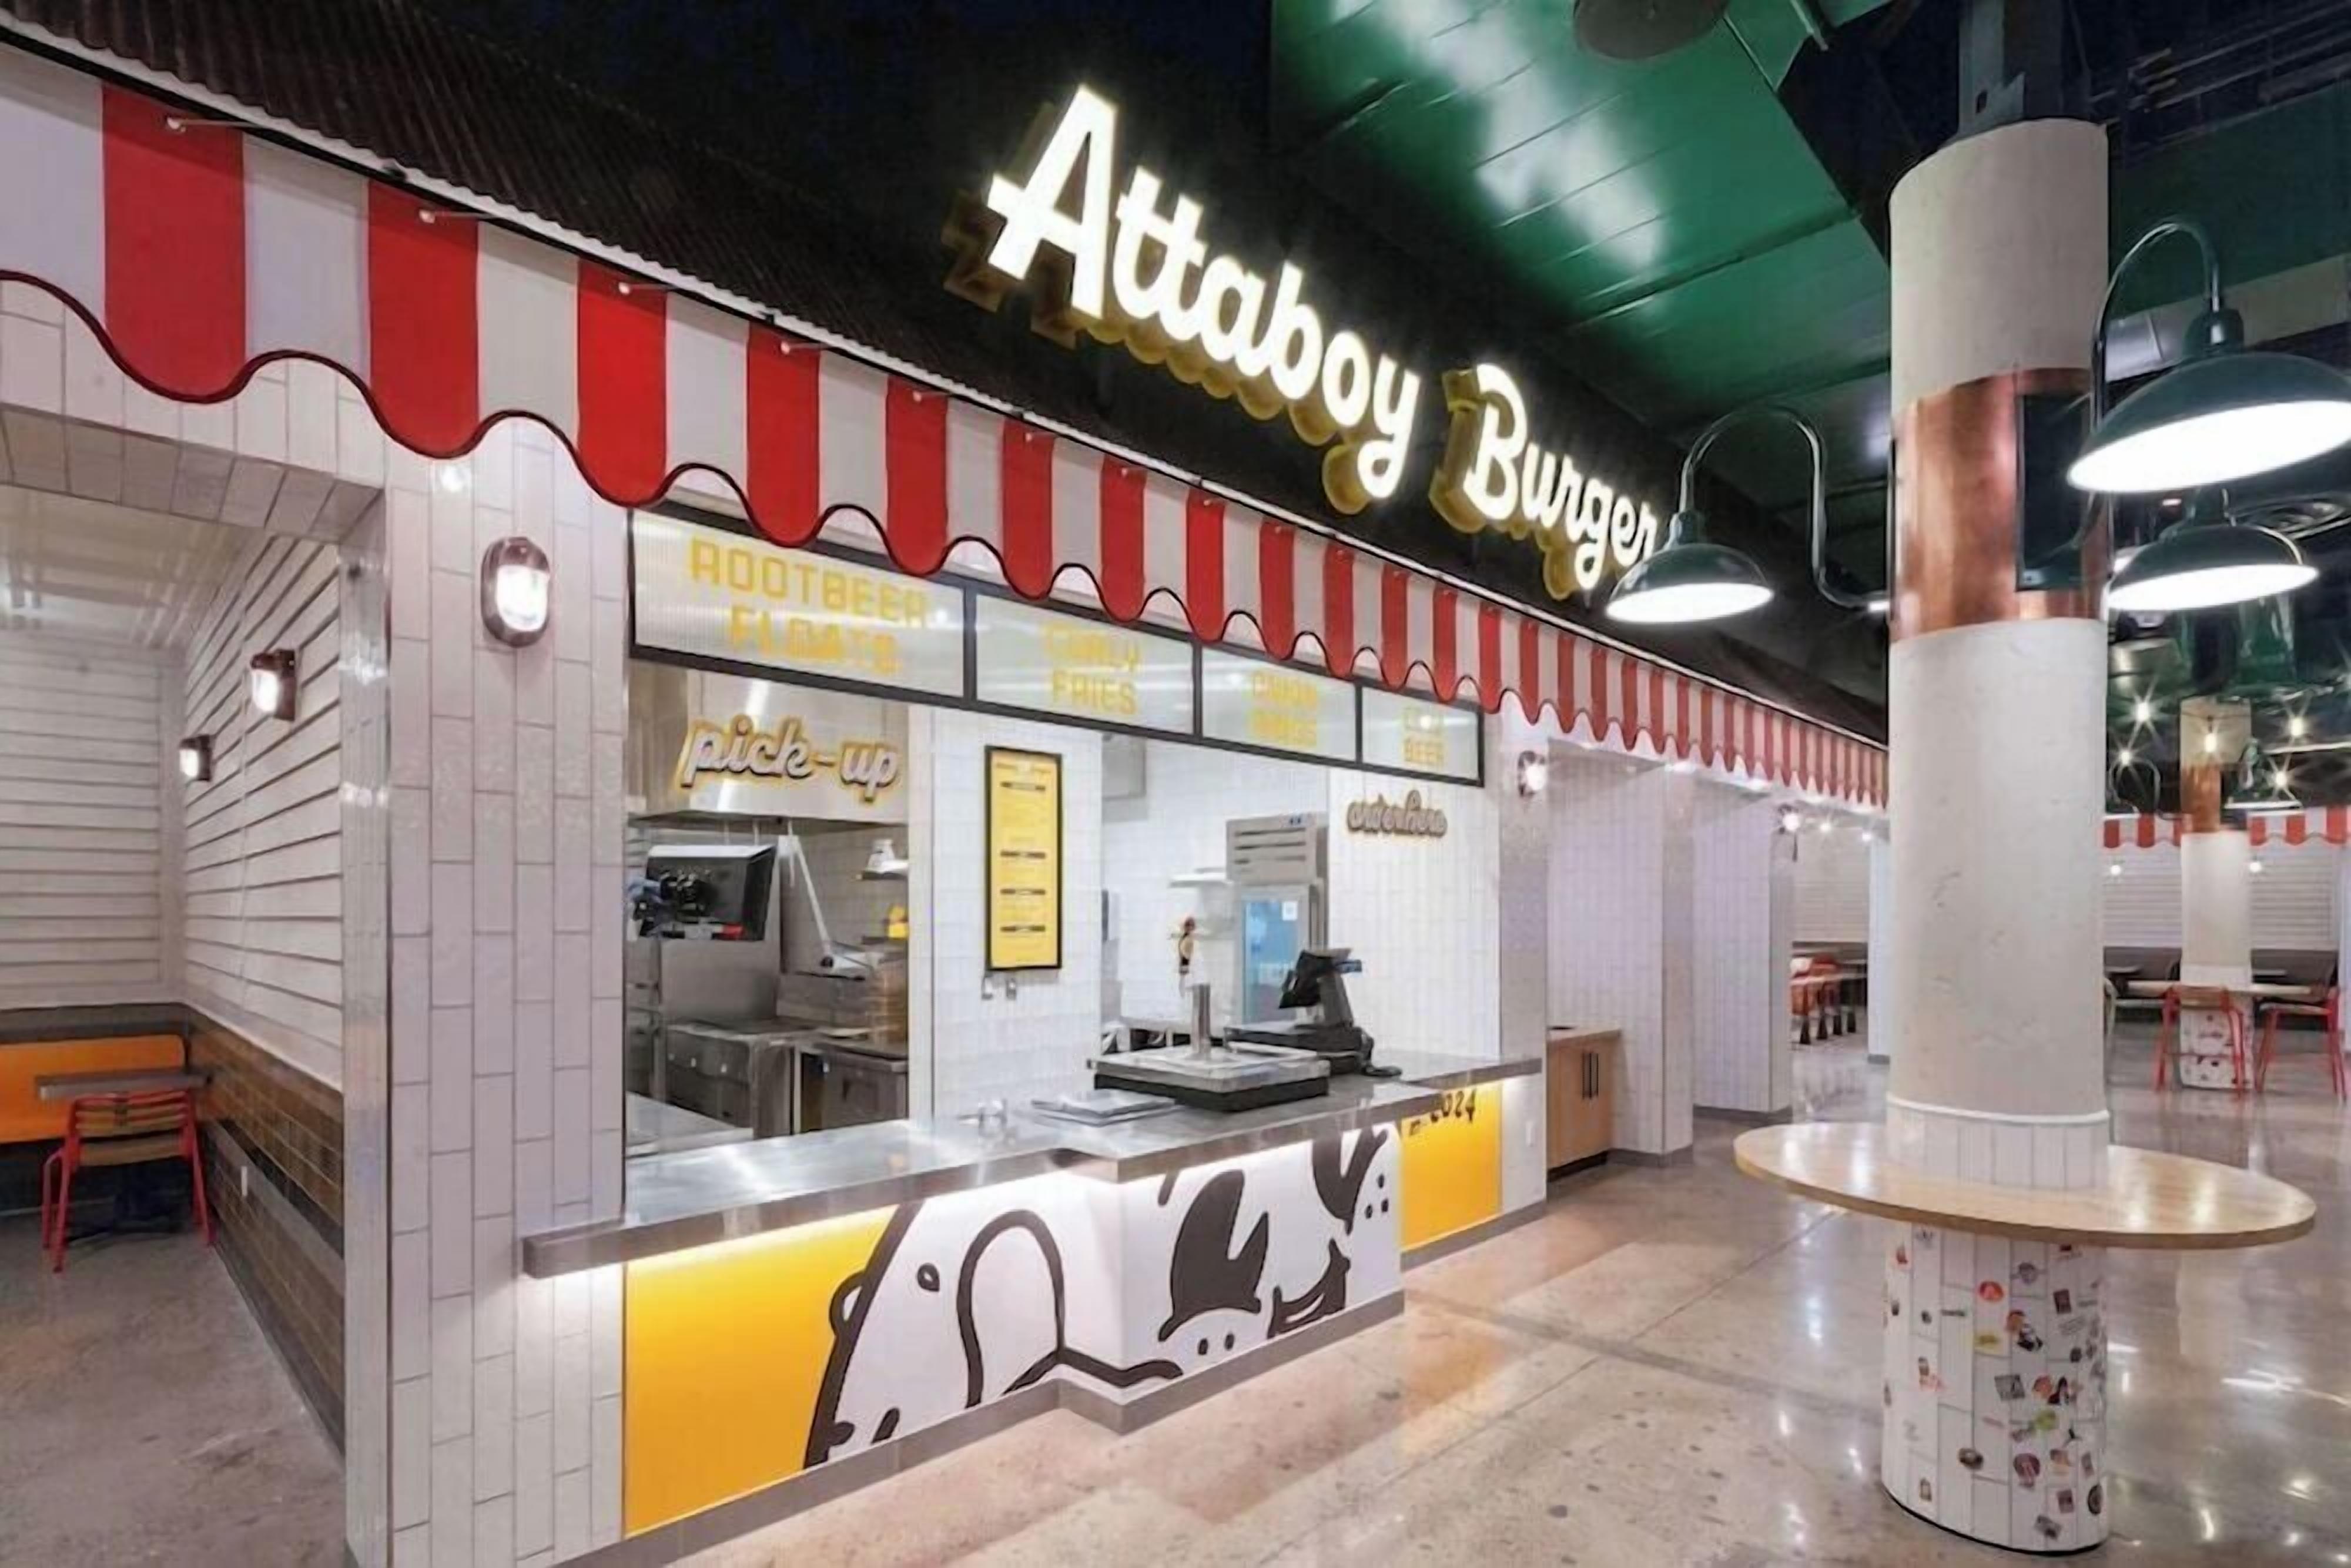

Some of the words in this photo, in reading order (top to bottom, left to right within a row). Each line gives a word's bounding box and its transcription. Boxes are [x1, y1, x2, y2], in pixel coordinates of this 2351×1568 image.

[987, 84, 1421, 500] Attaboy
[1462, 363, 1659, 589] Burger
[679, 715, 899, 802] pick-up
